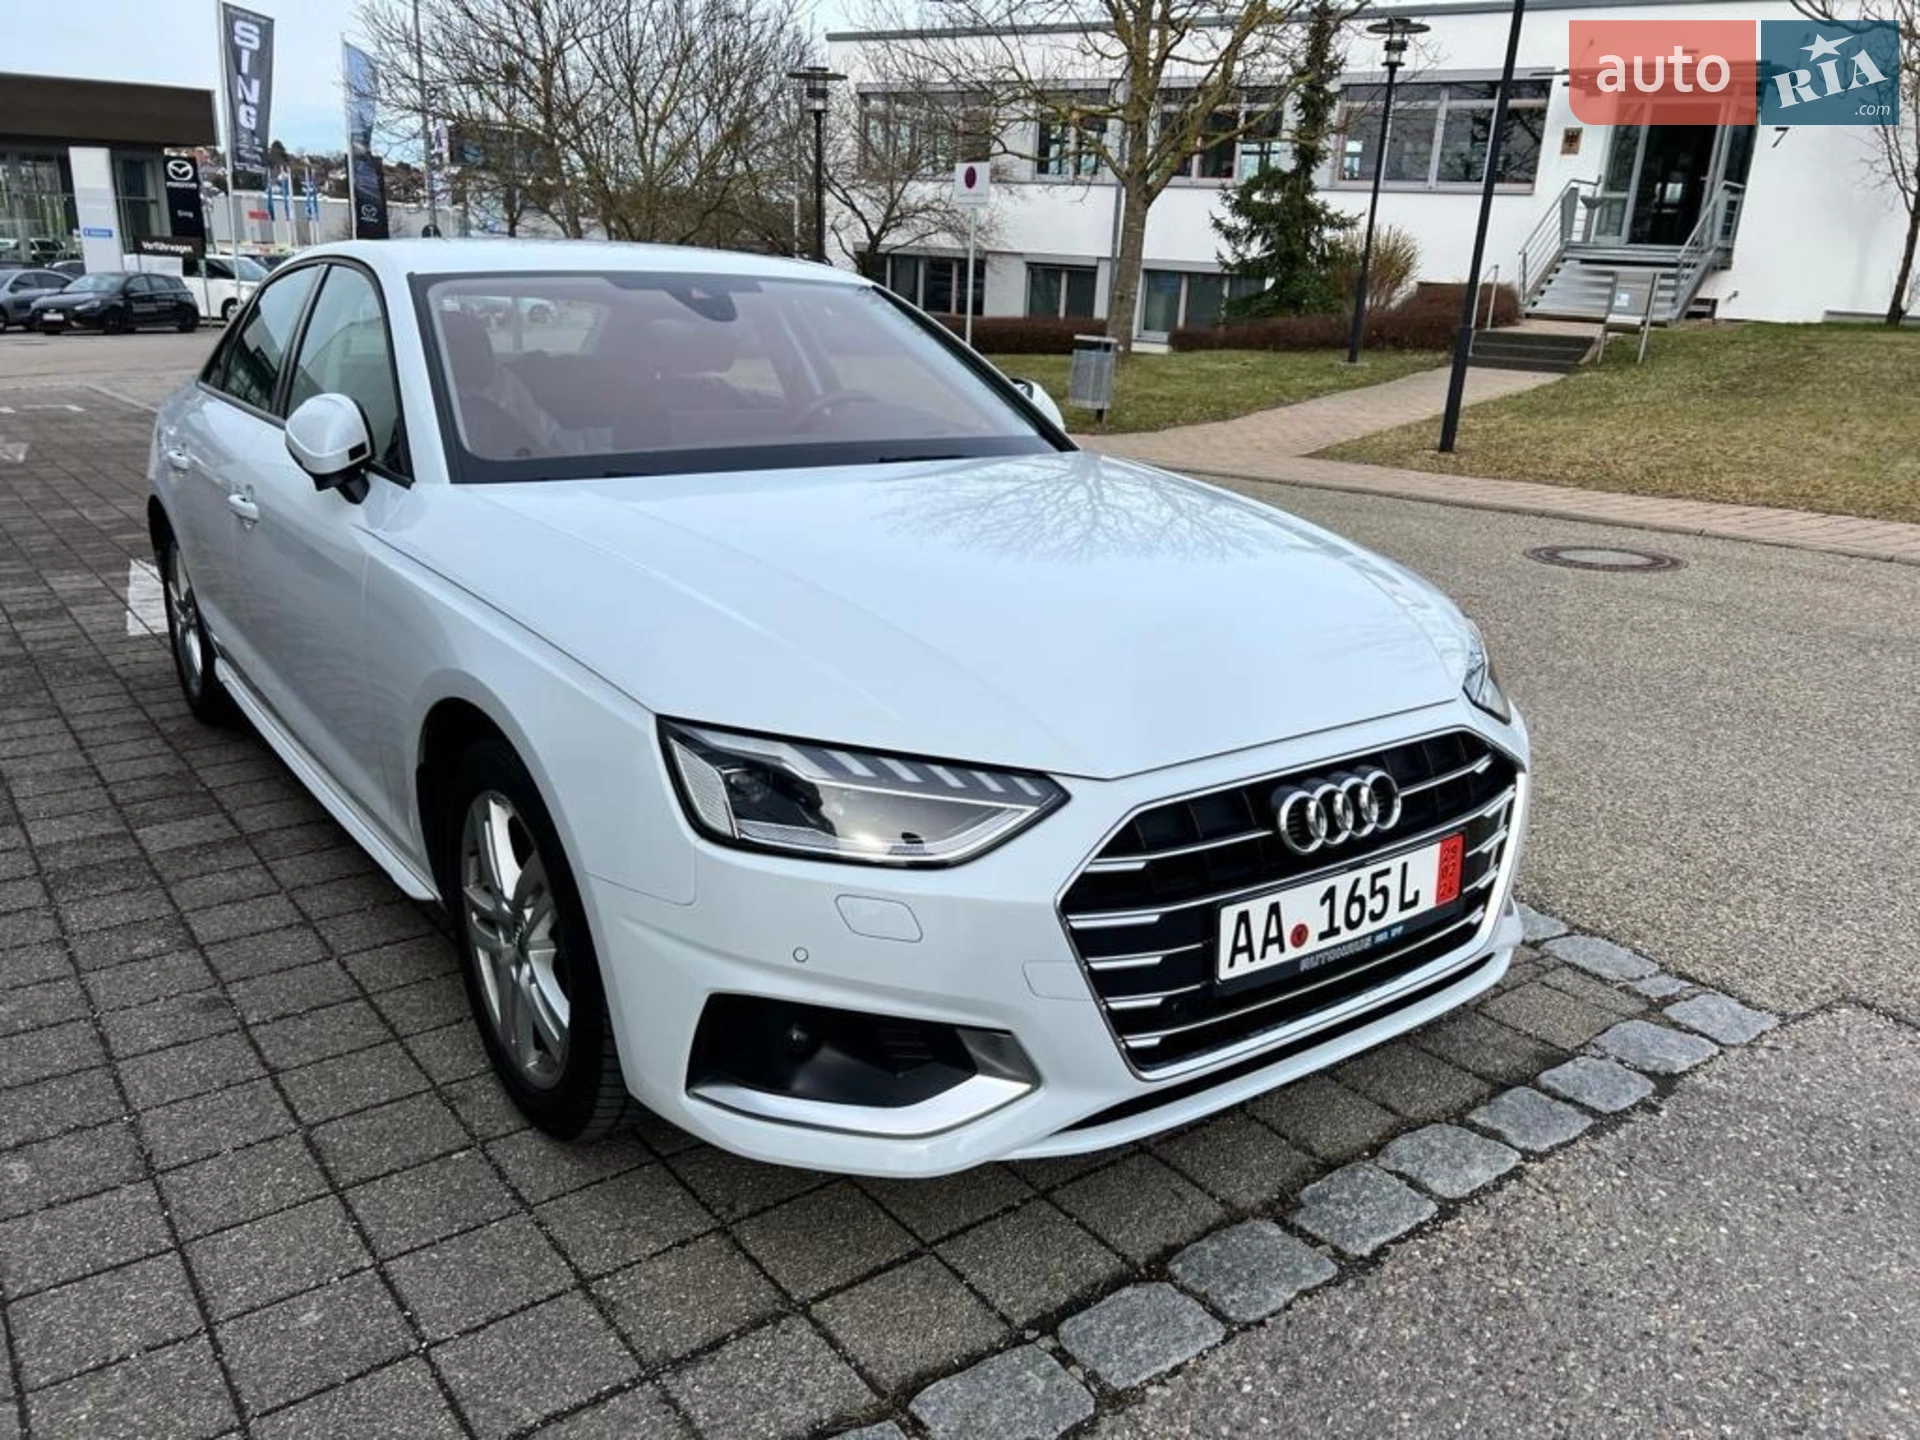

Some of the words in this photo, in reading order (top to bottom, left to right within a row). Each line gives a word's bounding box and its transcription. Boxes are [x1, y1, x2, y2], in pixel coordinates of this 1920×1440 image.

[233, 19, 260, 130] SING
[1772, 126, 1791, 149] 7
[1228, 901, 1286, 968] AA
